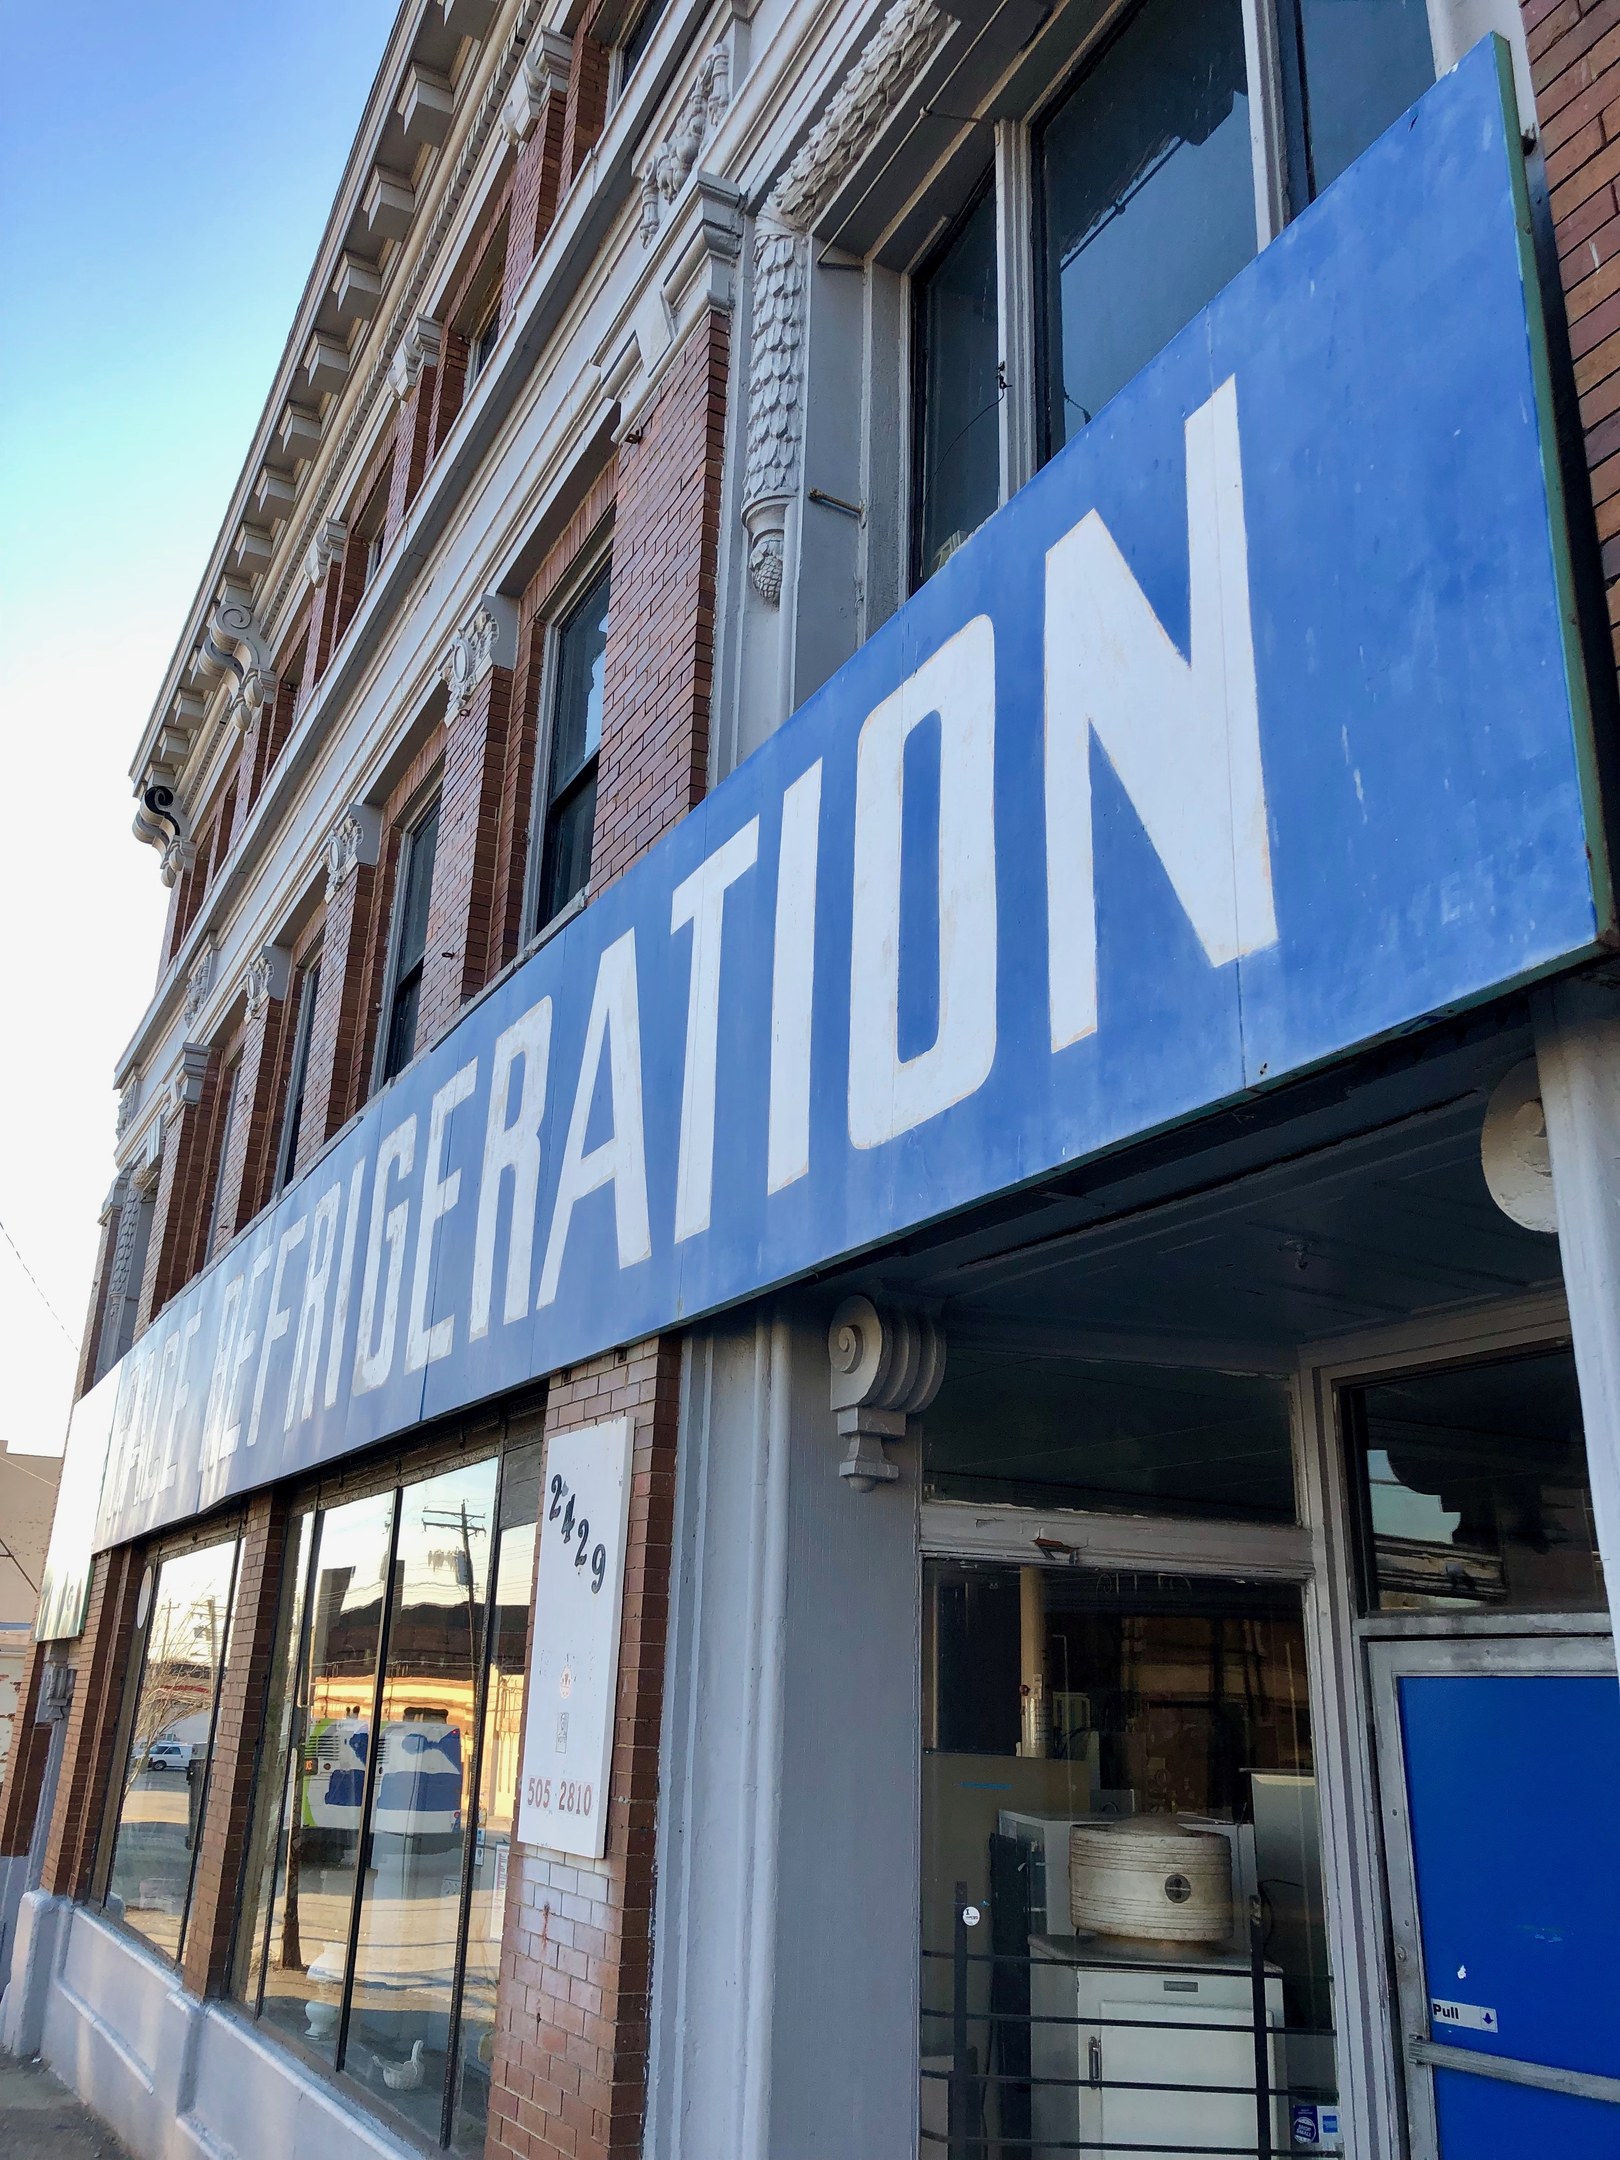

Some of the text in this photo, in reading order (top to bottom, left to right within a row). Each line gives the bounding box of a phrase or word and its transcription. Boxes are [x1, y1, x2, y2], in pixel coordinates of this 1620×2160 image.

[198, 374, 1280, 1473] REFRIGERATION
[549, 1473, 606, 1594] 2429
[527, 1777, 592, 1817] 505 2810
[1432, 2003, 1459, 2020] Pull
